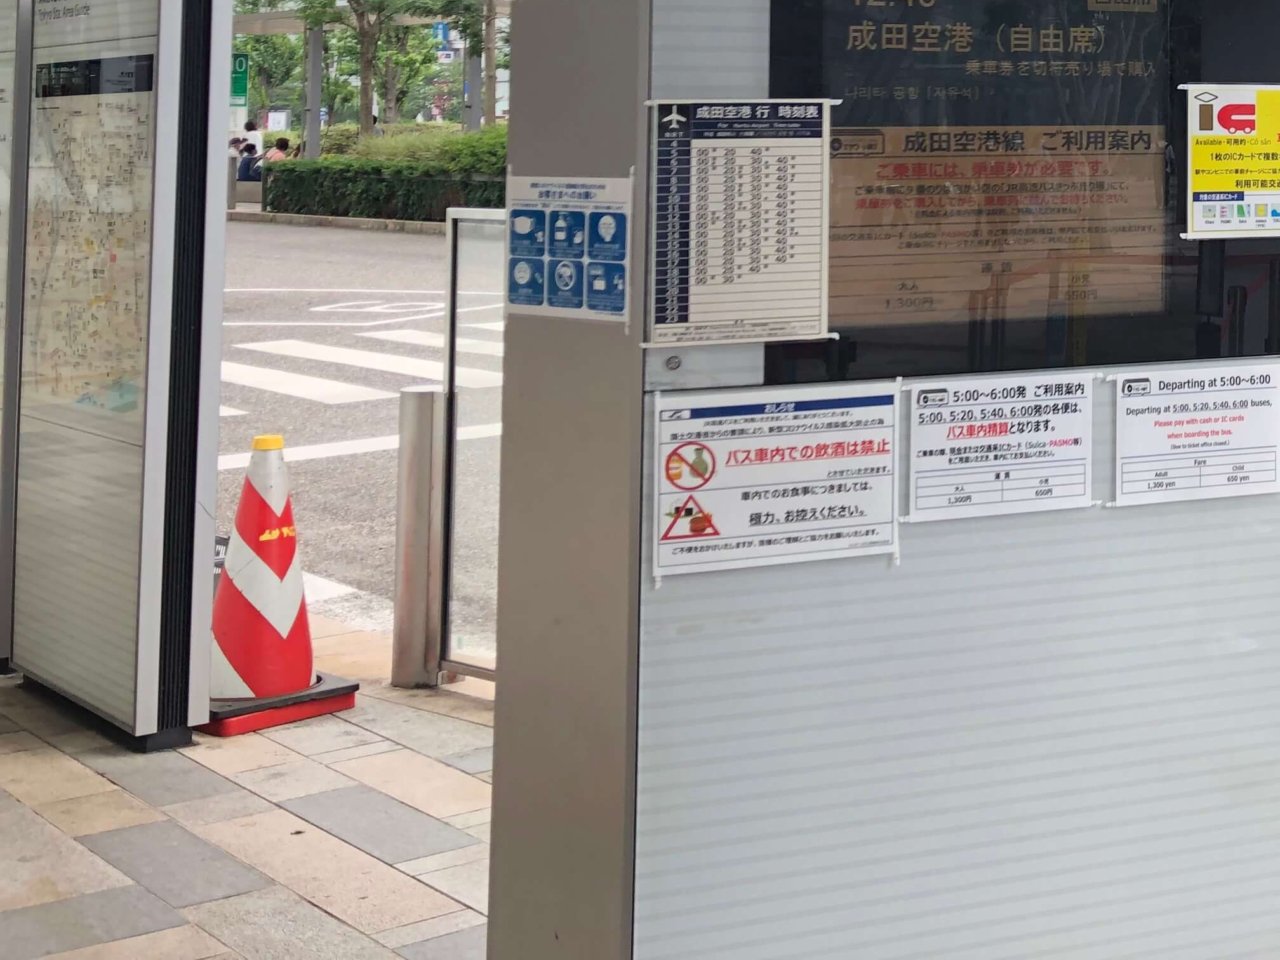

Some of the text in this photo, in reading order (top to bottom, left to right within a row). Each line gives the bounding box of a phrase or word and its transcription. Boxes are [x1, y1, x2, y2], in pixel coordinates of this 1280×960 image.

[696, 105, 752, 119] 成田空港
[756, 105, 770, 118] 行
[903, 130, 1025, 153] 成田空港線
[1041, 129, 1151, 152] ご利用案内
[1034, 382, 1085, 397] ご利用案内
[1158, 379, 1205, 392] Departing
[1208, 378, 1217, 388] at
[1126, 404, 1161, 416] Departing
[1232, 400, 1248, 409] 6:00
[1250, 400, 1272, 408] buses,
[1184, 430, 1209, 438] boarding
[725, 438, 890, 466] バス車内での飲酒は禁止
